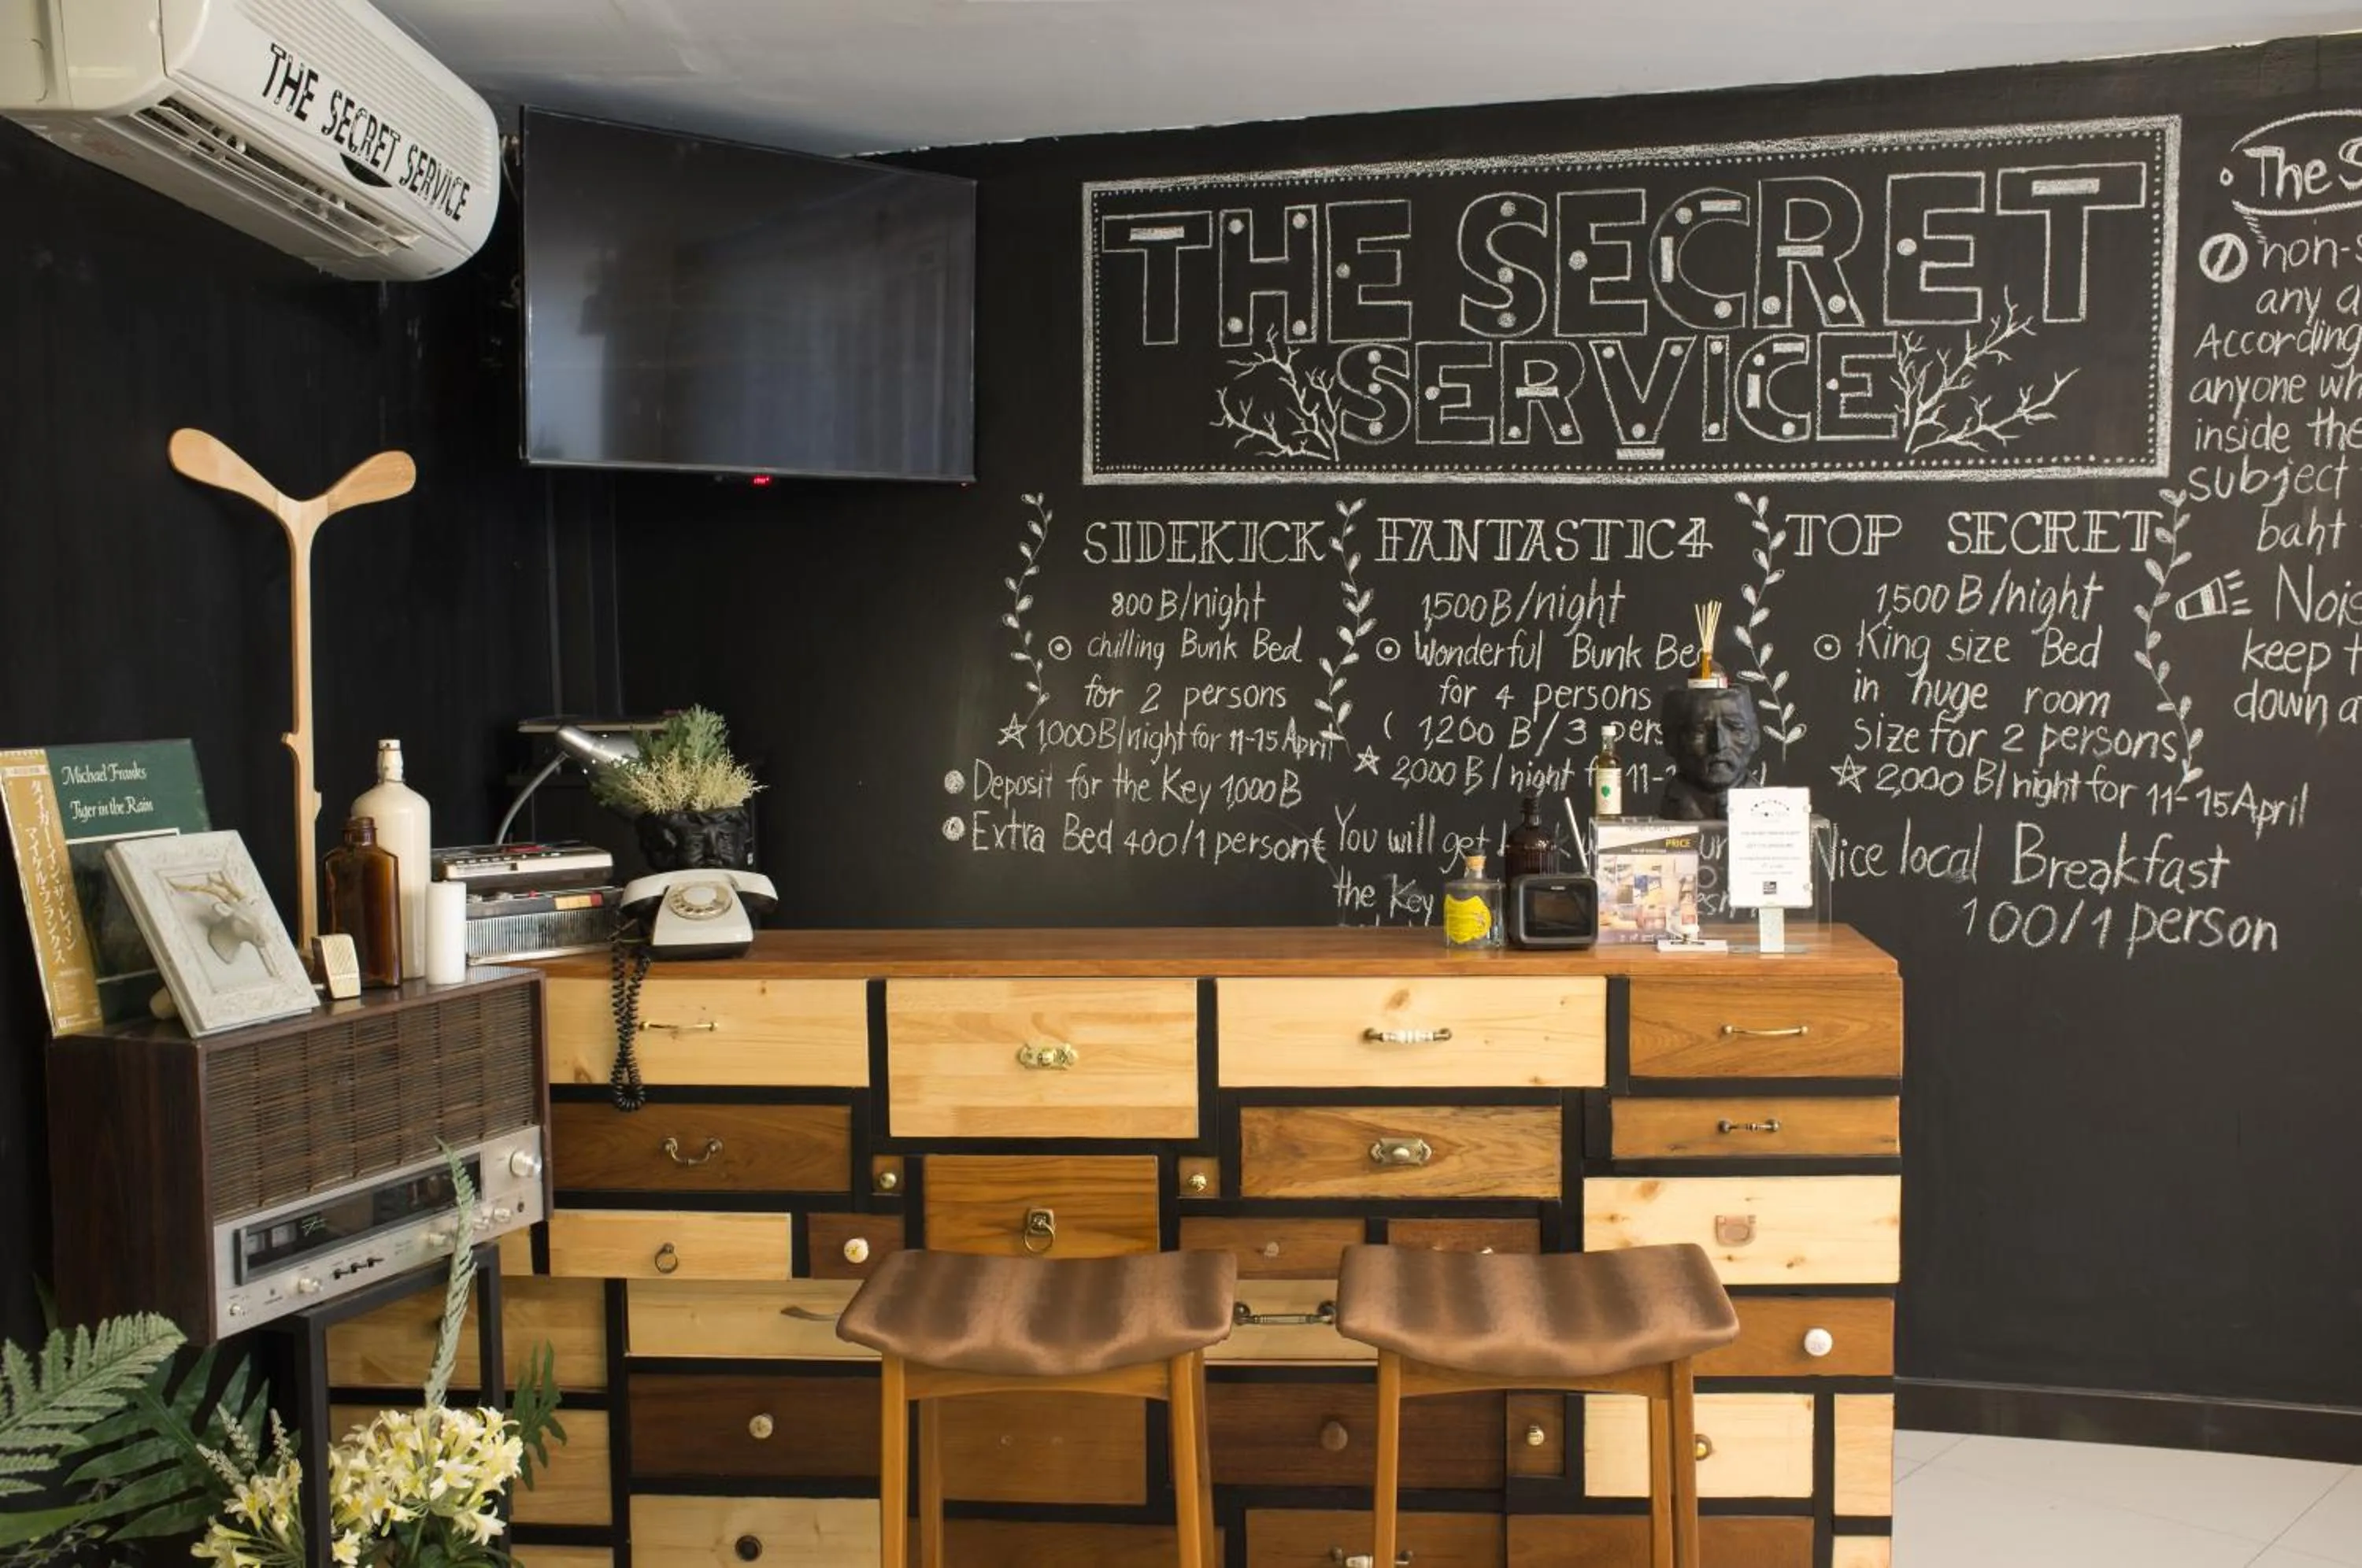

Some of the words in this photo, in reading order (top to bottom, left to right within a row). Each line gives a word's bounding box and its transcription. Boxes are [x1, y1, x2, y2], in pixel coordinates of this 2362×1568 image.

[262, 43, 319, 122] THE
[321, 89, 401, 172] SECRET
[398, 144, 470, 221] SERVICE
[2242, 145, 2333, 202] The
[1102, 199, 1412, 346] THE
[1457, 162, 2146, 337] SECRET
[2256, 286, 2322, 326] any
[2193, 319, 2362, 369] According
[1337, 331, 1898, 446] SERVICE
[2188, 373, 2307, 420] anyone
[2195, 411, 2291, 453] inside
[2188, 453, 2349, 508] subject
[1083, 520, 1327, 564] SIDEKICK
[1785, 512, 1902, 557] TOP
[1947, 510, 2164, 556] SECRET
[2256, 506, 2346, 556] baht
[1180, 628, 1239, 660] Bunk
[1252, 625, 1304, 664] Bed
[1413, 627, 1544, 672] Wonderful
[1571, 632, 1642, 672] Bunk
[1654, 632, 1704, 671] Be
[1857, 619, 1931, 679] King
[1946, 628, 2010, 664] size
[2041, 625, 2103, 669] Bed
[2242, 627, 2332, 693] keep
[1084, 672, 1124, 709] for
[1140, 682, 1162, 714] 2
[1183, 682, 1287, 721] persons
[1438, 673, 1478, 708] for
[1495, 682, 1515, 712] 4
[1532, 682, 1653, 723] persons
[1853, 668, 1880, 704] in
[1911, 668, 1989, 724] huge
[2023, 686, 2112, 718] room
[2233, 678, 2328, 734] down
[1190, 722, 1222, 753] for
[1281, 715, 1335, 763] April
[1929, 710, 1988, 758] for
[2001, 723, 2025, 753] 2
[2038, 719, 2178, 768] persons
[61, 763, 108, 786] Michael
[973, 757, 1054, 811] Deposit
[1064, 762, 1103, 801] for
[1112, 761, 1153, 803] the
[1161, 762, 1212, 815] Key
[2085, 764, 2139, 810] for
[2231, 780, 2309, 842] April
[971, 809, 1046, 854] Extra
[1063, 812, 1113, 855] Bed
[1334, 802, 1378, 853] You
[1386, 811, 1436, 855] will
[1439, 825, 1491, 875] get
[1664, 838, 1691, 849] PRICE
[1812, 820, 1889, 883] Nice
[1900, 817, 1983, 885] local
[2011, 820, 2231, 895] Breakfast
[1331, 864, 1376, 911] the
[1383, 873, 1434, 927] Key
[2126, 901, 2279, 960] person
